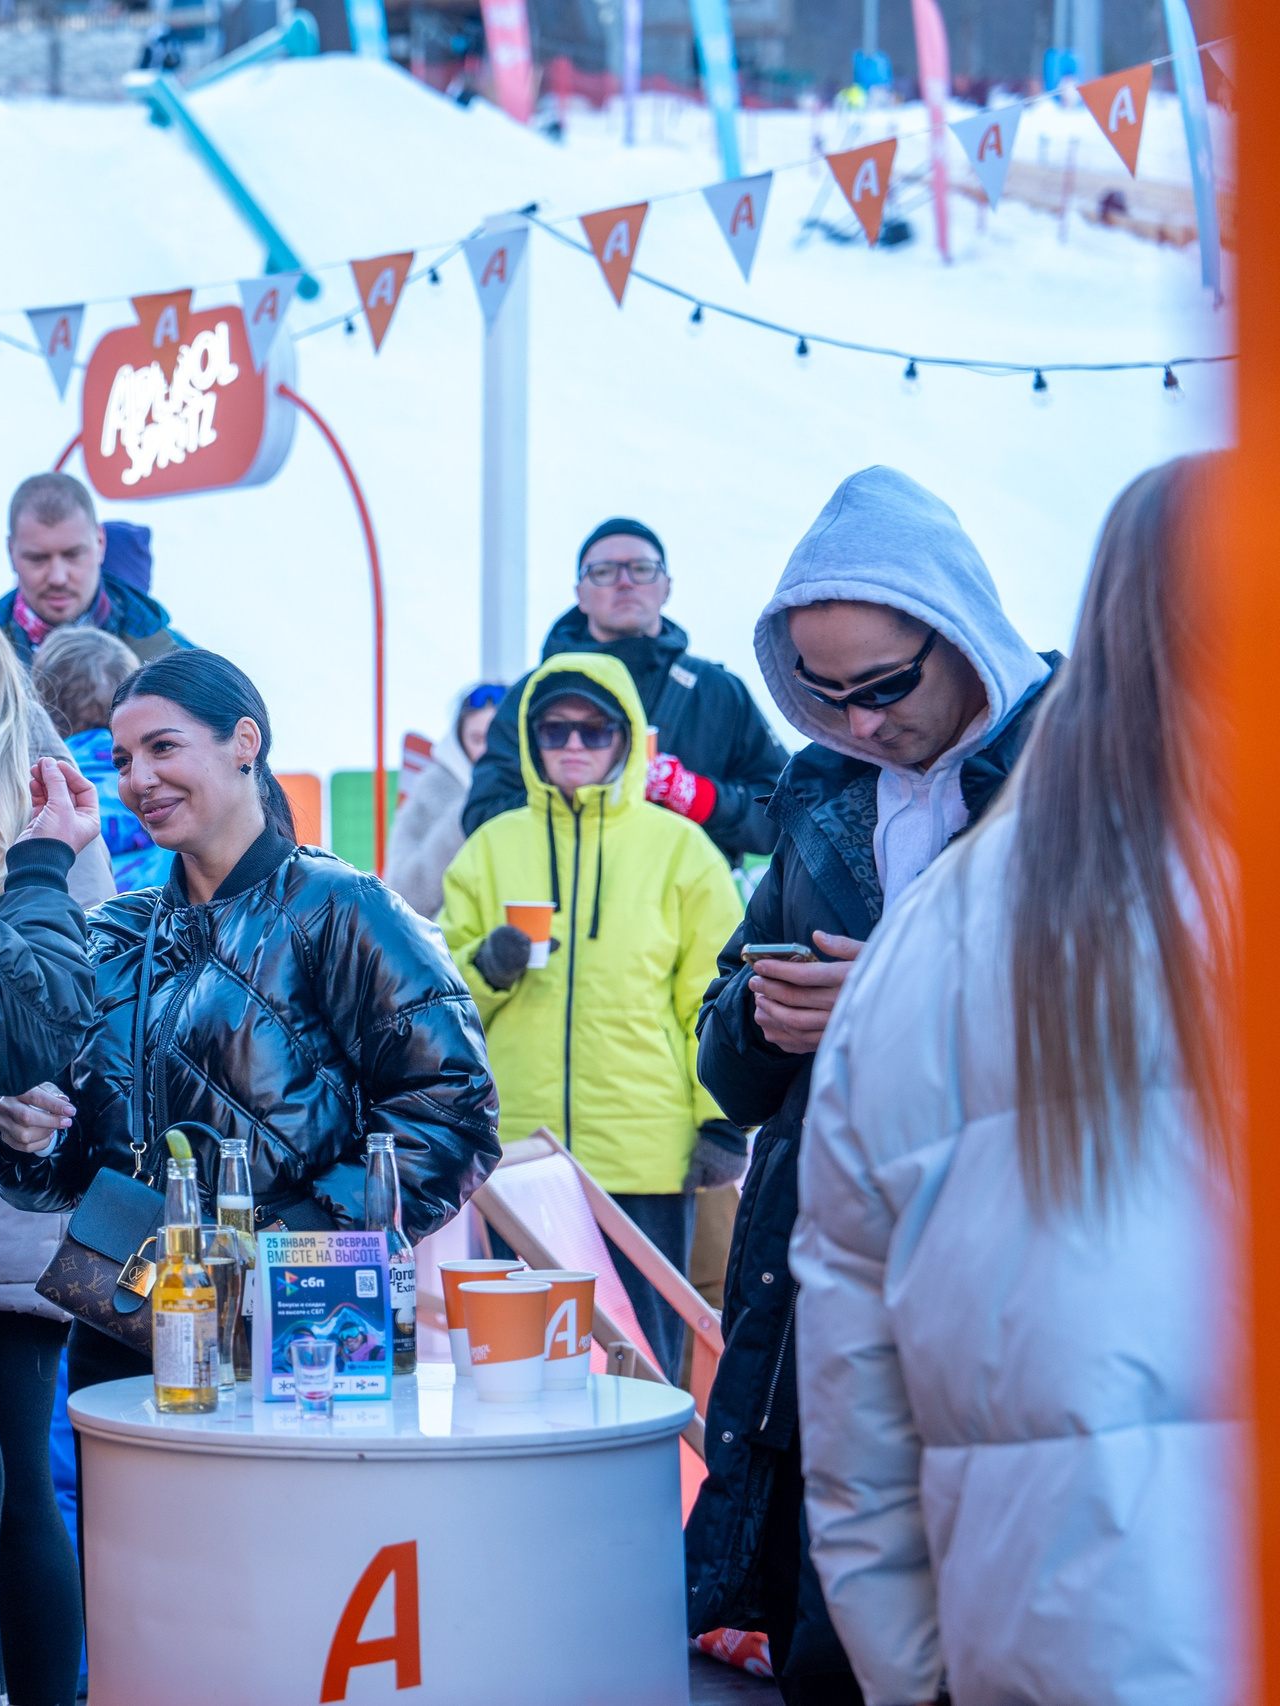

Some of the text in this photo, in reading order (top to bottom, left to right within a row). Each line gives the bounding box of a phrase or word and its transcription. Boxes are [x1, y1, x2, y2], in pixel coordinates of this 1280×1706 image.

[1109, 86, 1137, 133] A
[977, 123, 1003, 163] A
[851, 157, 880, 203] A
[730, 193, 755, 236] A
[602, 219, 630, 264] A
[366, 267, 395, 309] A
[480, 247, 507, 287] A
[153, 305, 179, 348] A
[253, 287, 279, 325] A
[49, 315, 71, 357] A
[266, 1238, 278, 1248] 25
[280, 1237, 316, 1248] ЯНВАРЯ
[328, 1237, 334, 1248] 2
[336, 1236, 380, 1248] ФЕВРАЛЯ
[267, 1248, 382, 1263] ВМЕСТЕ НА ВЫСОТЕ
[300, 1276, 325, 1288] сбп
[277, 1301, 299, 1309] Бонусы
[544, 1298, 578, 1362] A
[319, 1539, 422, 1704] A
